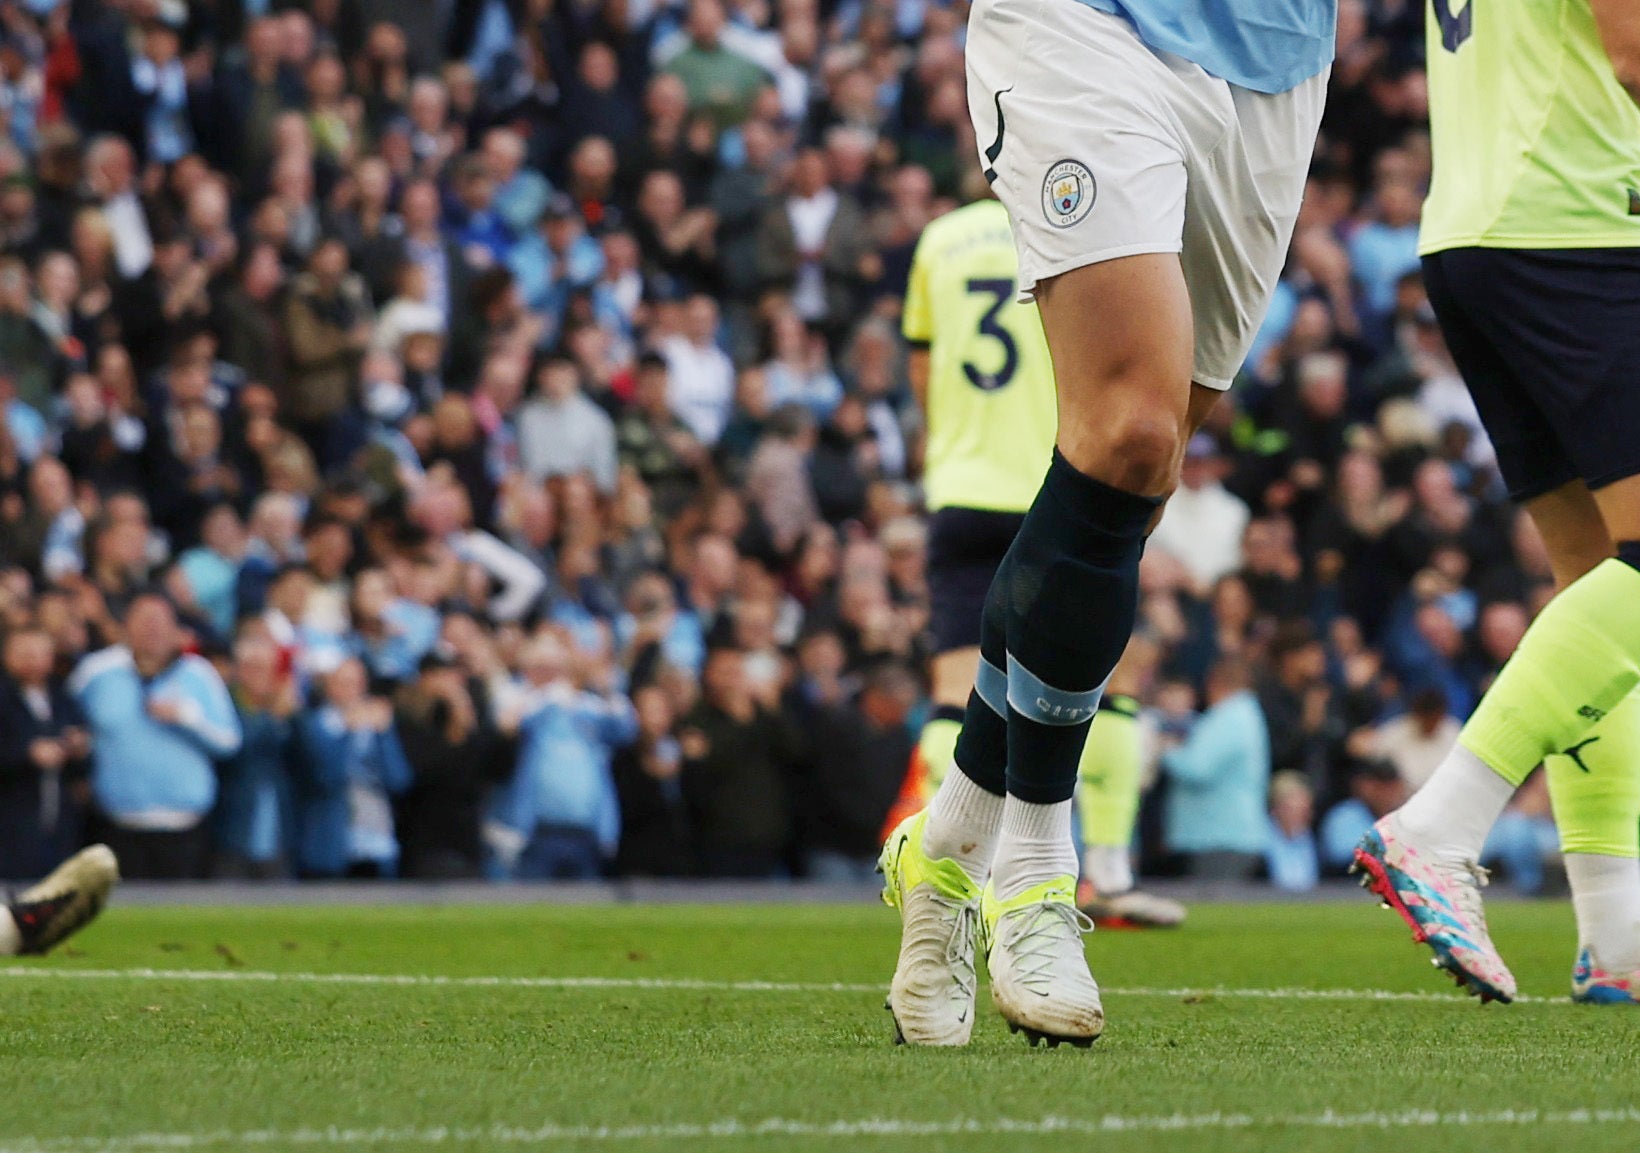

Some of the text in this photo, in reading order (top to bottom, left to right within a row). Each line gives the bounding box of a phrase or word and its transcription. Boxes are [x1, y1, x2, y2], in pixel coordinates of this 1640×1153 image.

[1045, 164, 1088, 193] MANCHESTER
[1061, 214, 1077, 224] CITY
[962, 278, 1018, 391] 3
